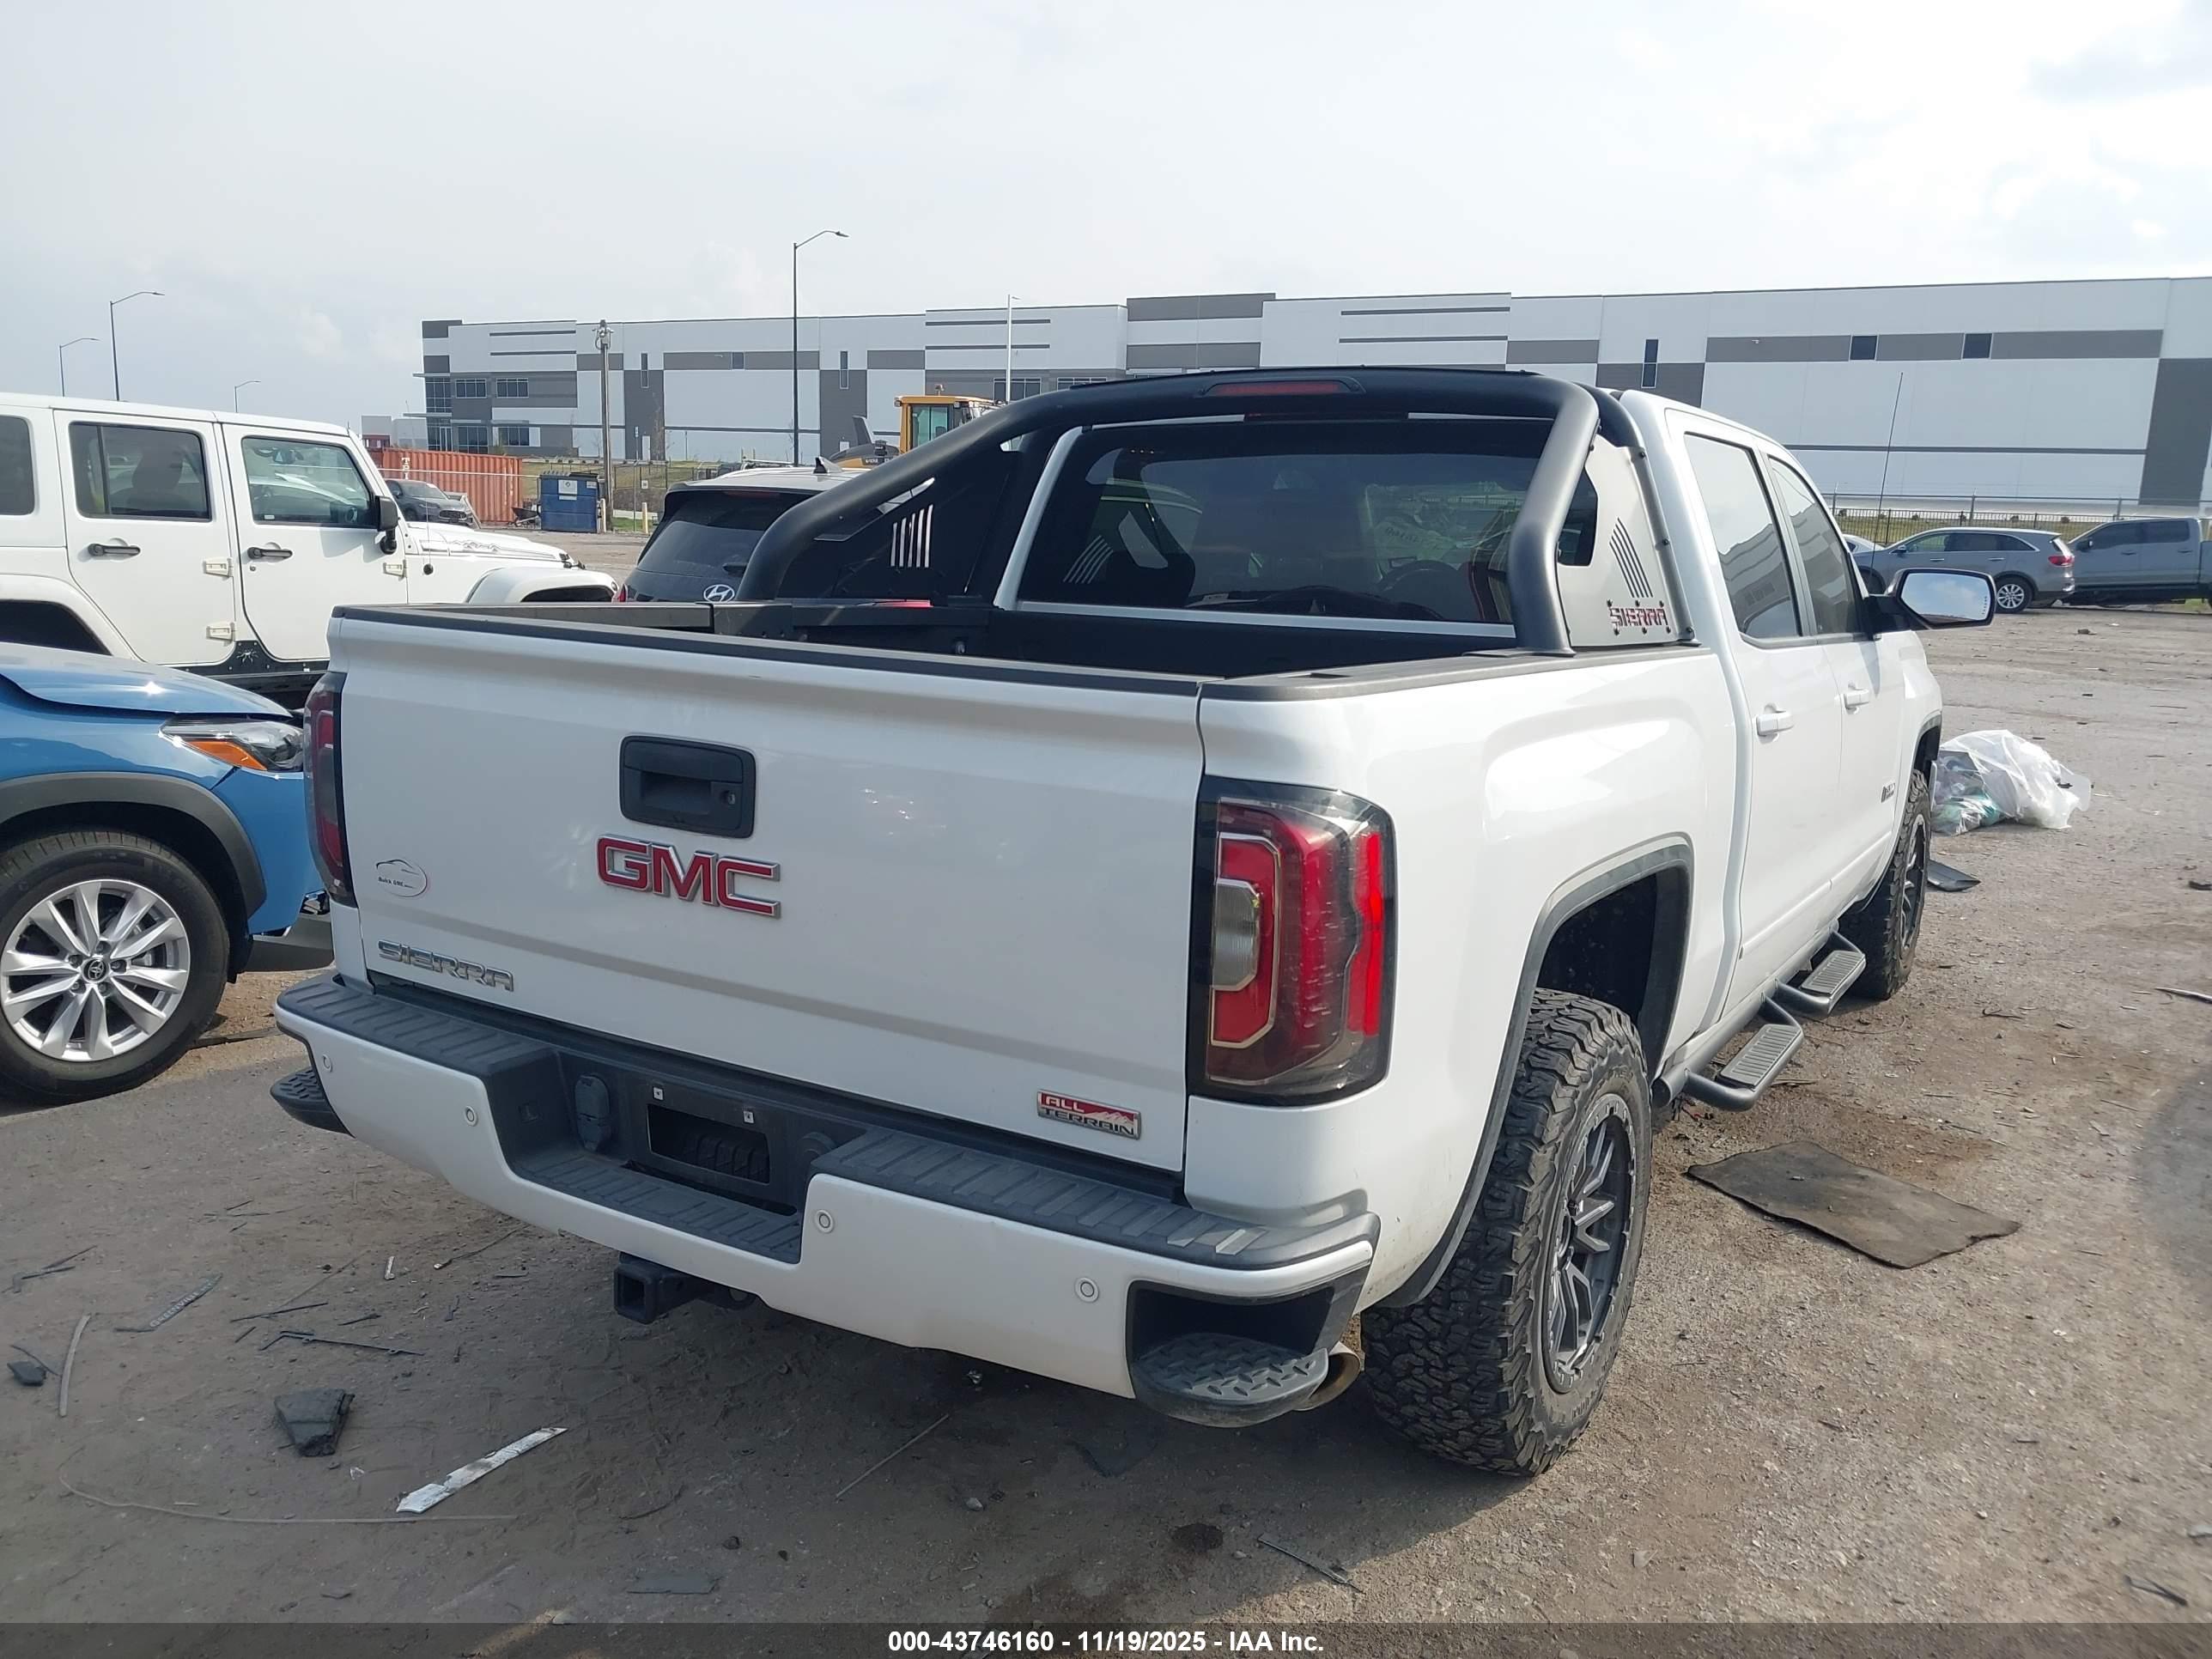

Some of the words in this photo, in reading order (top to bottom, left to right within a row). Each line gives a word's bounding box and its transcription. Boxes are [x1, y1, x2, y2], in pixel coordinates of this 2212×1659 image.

[1609, 607, 1668, 626] SIERRA
[597, 834, 781, 919] GMC
[378, 939, 514, 992] SIERRA
[1045, 1096, 1085, 1113] ALL
[1043, 1108, 1134, 1135] TERRAIN
